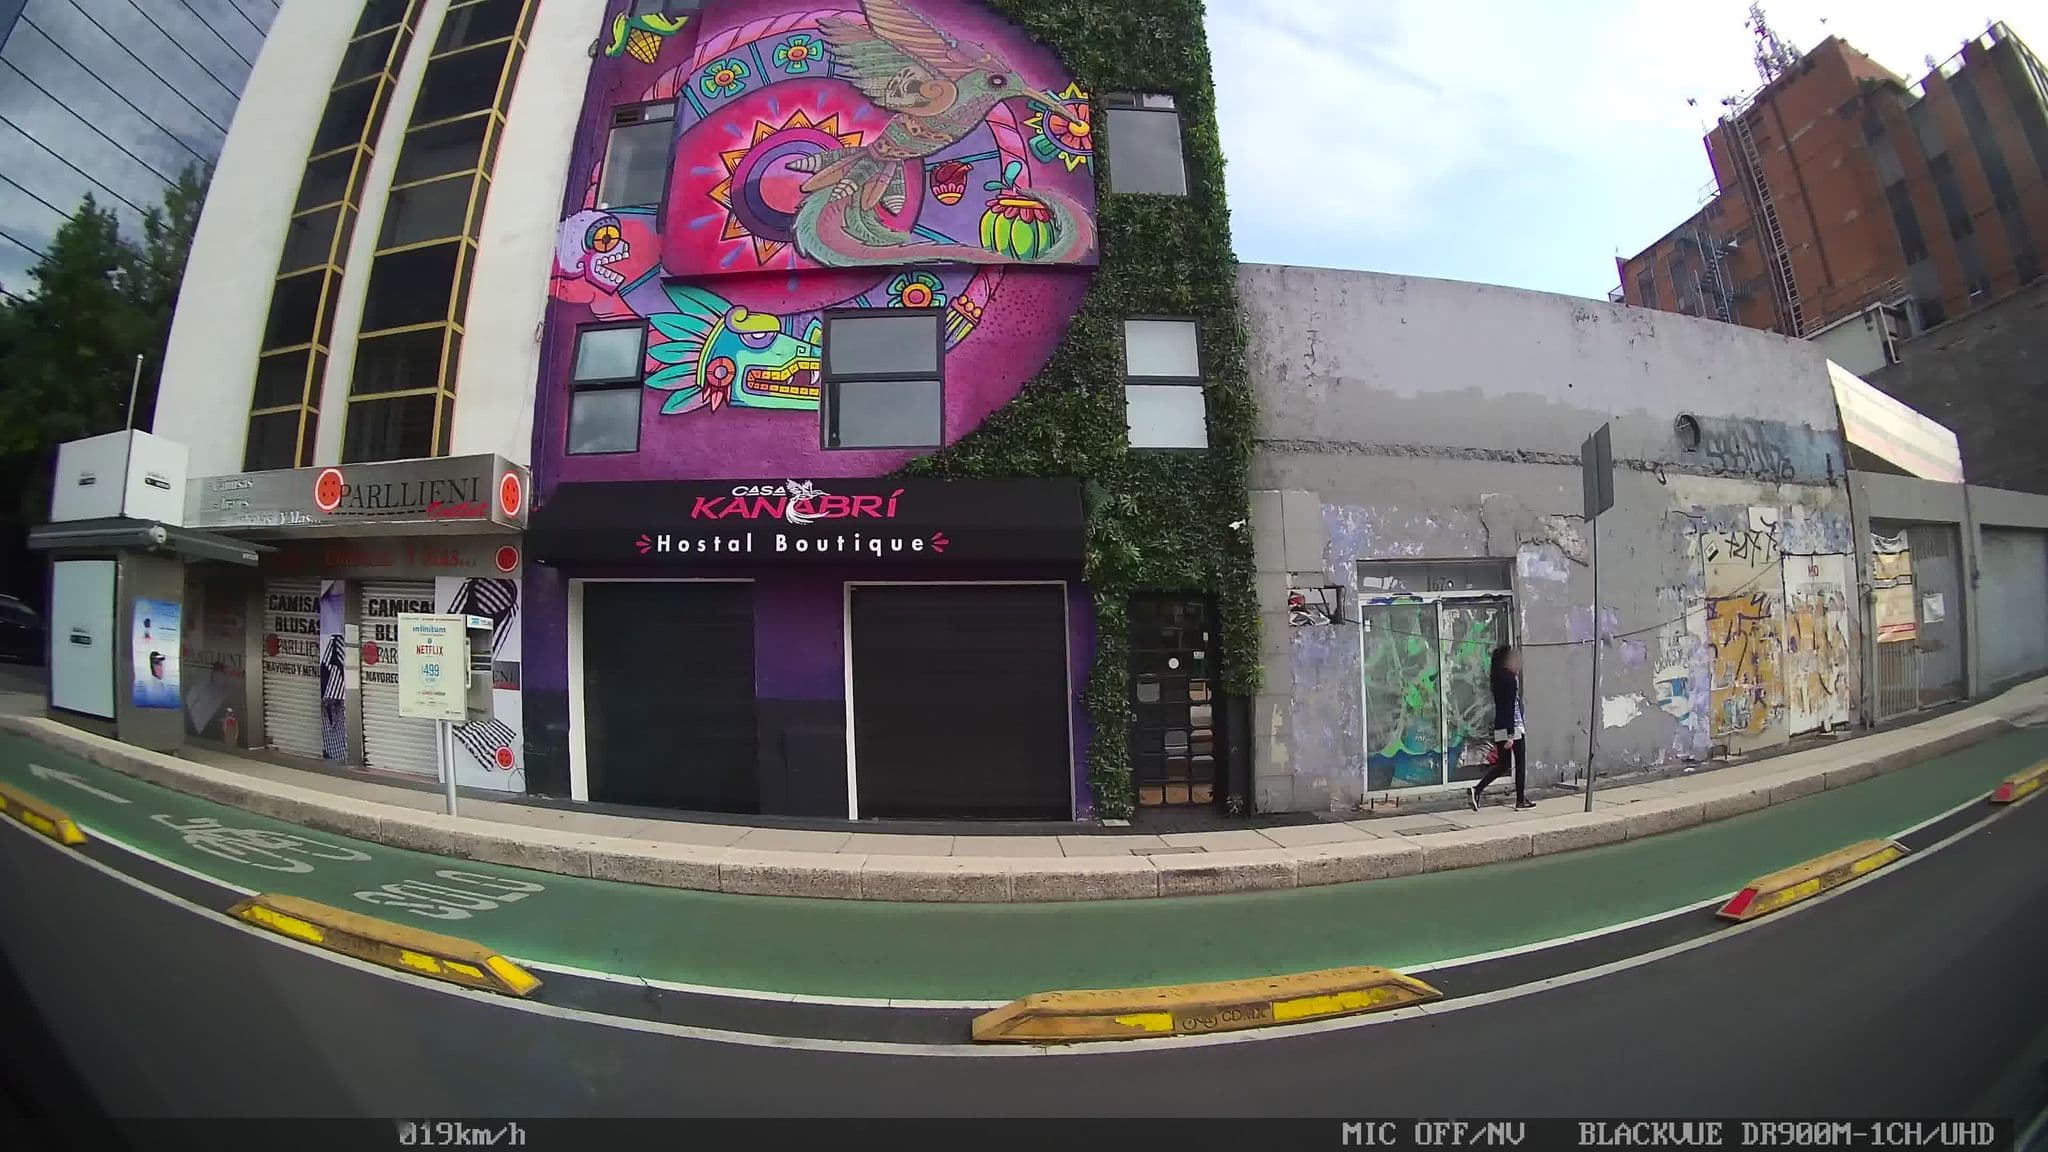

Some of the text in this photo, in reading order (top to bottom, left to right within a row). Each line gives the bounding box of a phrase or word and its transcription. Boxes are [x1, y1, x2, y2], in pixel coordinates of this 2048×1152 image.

[338, 477, 481, 509] PARLLIENI
[731, 485, 786, 496] CASA
[657, 533, 924, 557] Hostal Boutique
[416, 644, 443, 657] NETFLIX
[353, 870, 546, 920] SOLO
